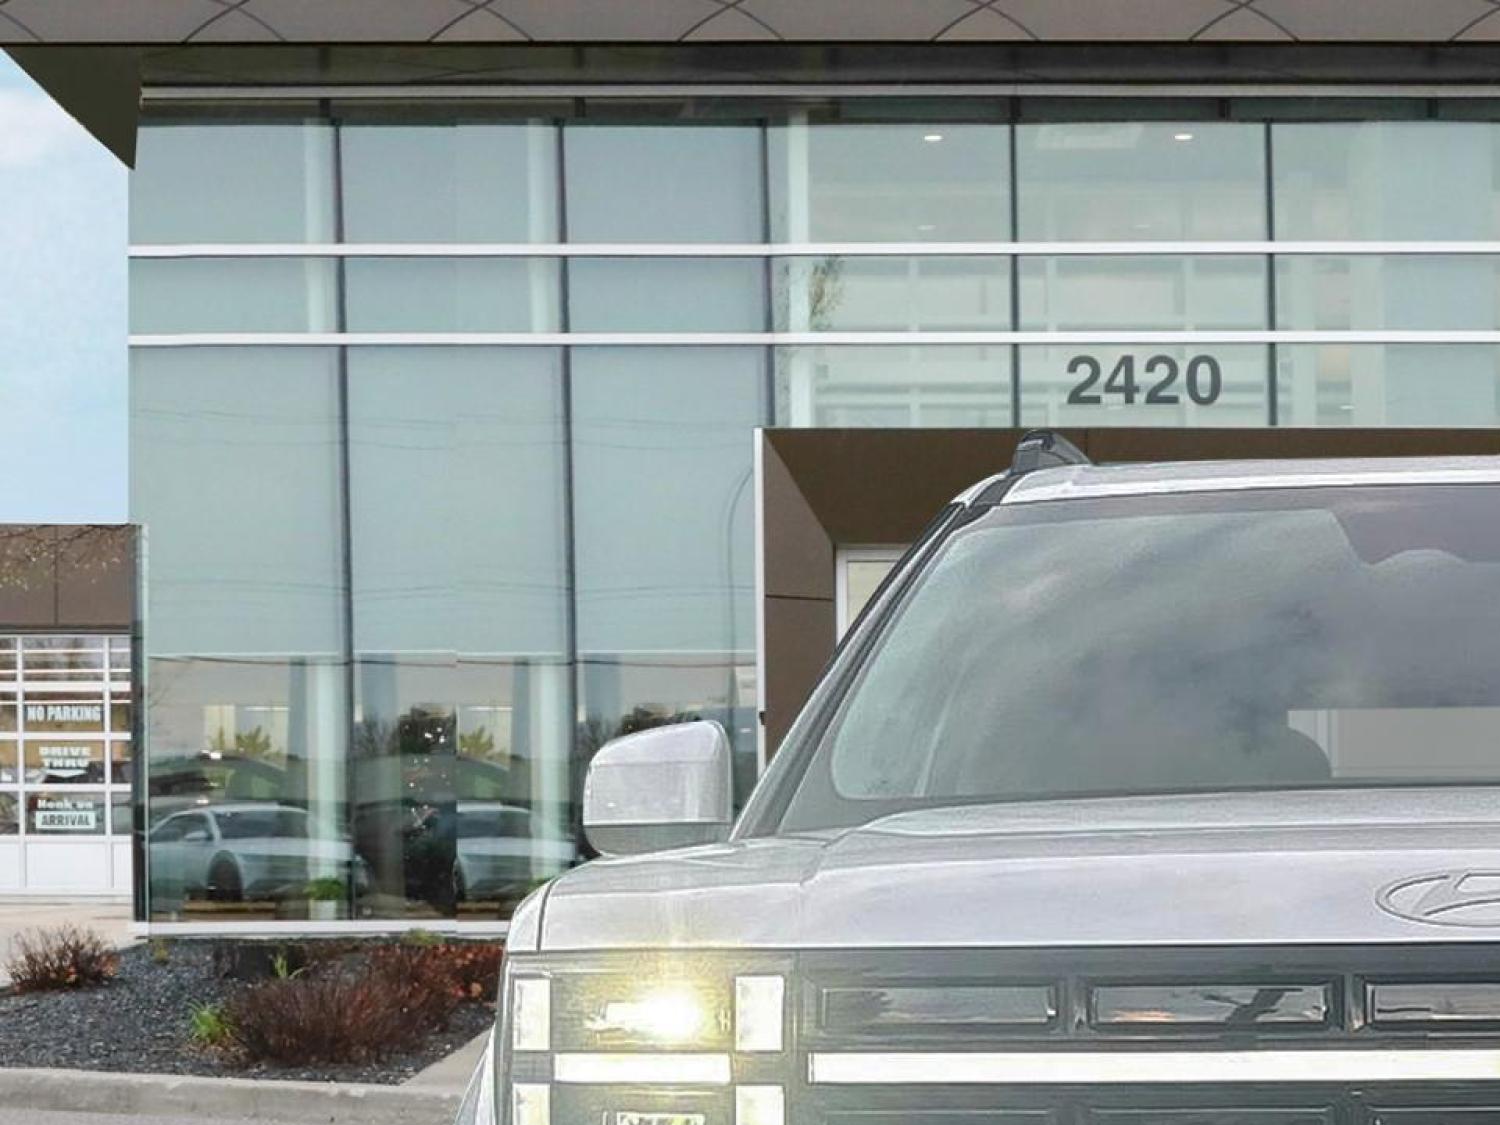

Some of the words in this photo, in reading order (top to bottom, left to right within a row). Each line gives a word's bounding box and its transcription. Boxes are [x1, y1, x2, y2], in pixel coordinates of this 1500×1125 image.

[1066, 354, 1222, 406] 2420
[46, 705, 101, 721] PARKING
[41, 814, 91, 826] ARRIVAL
